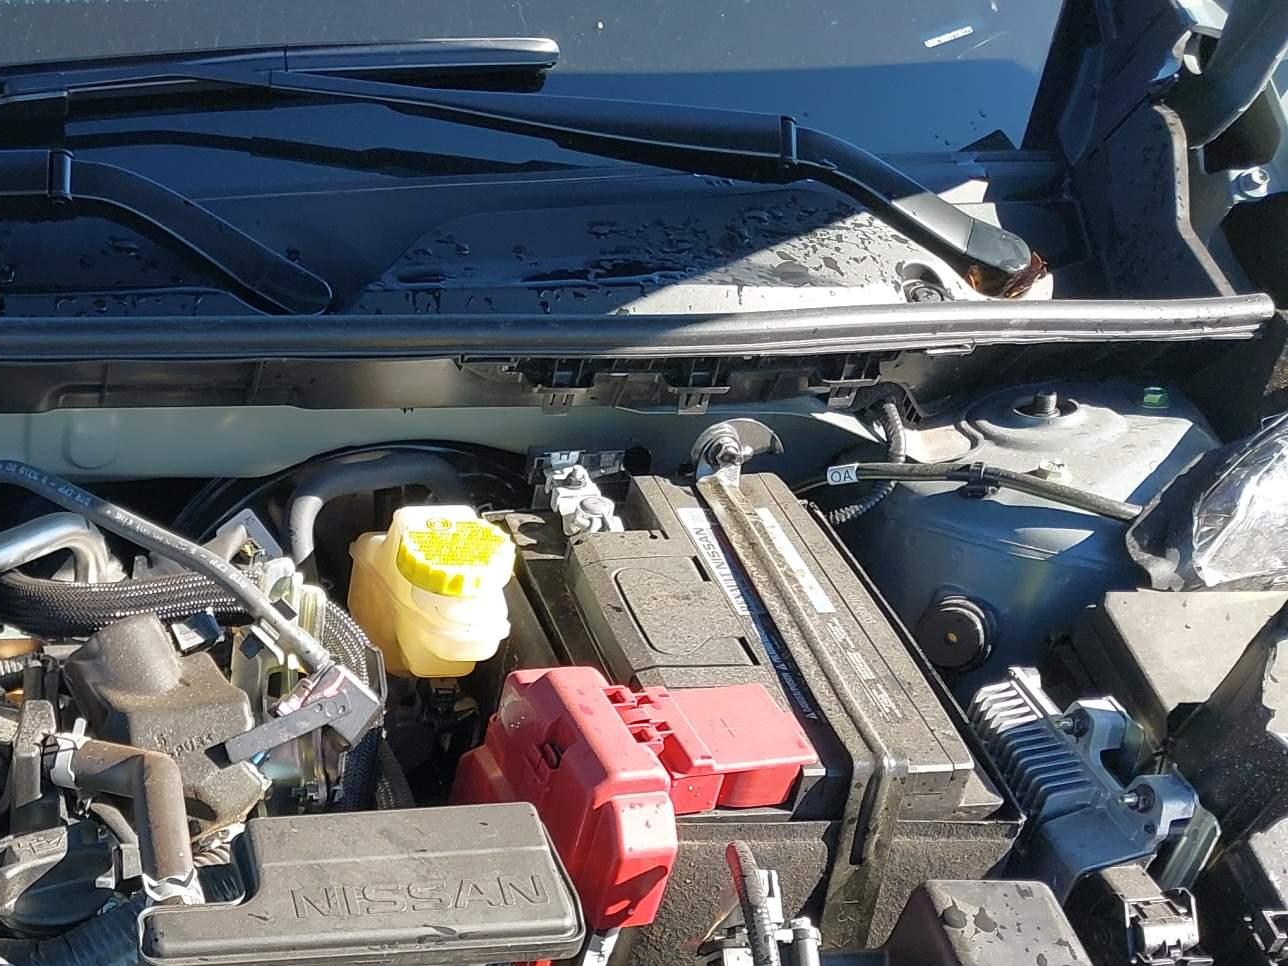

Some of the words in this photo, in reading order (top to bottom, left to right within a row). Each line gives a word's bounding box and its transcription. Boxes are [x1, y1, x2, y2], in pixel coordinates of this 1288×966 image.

[830, 469, 854, 483] OA
[693, 526, 725, 576] NISSAN
[289, 873, 551, 919] NISSAN
